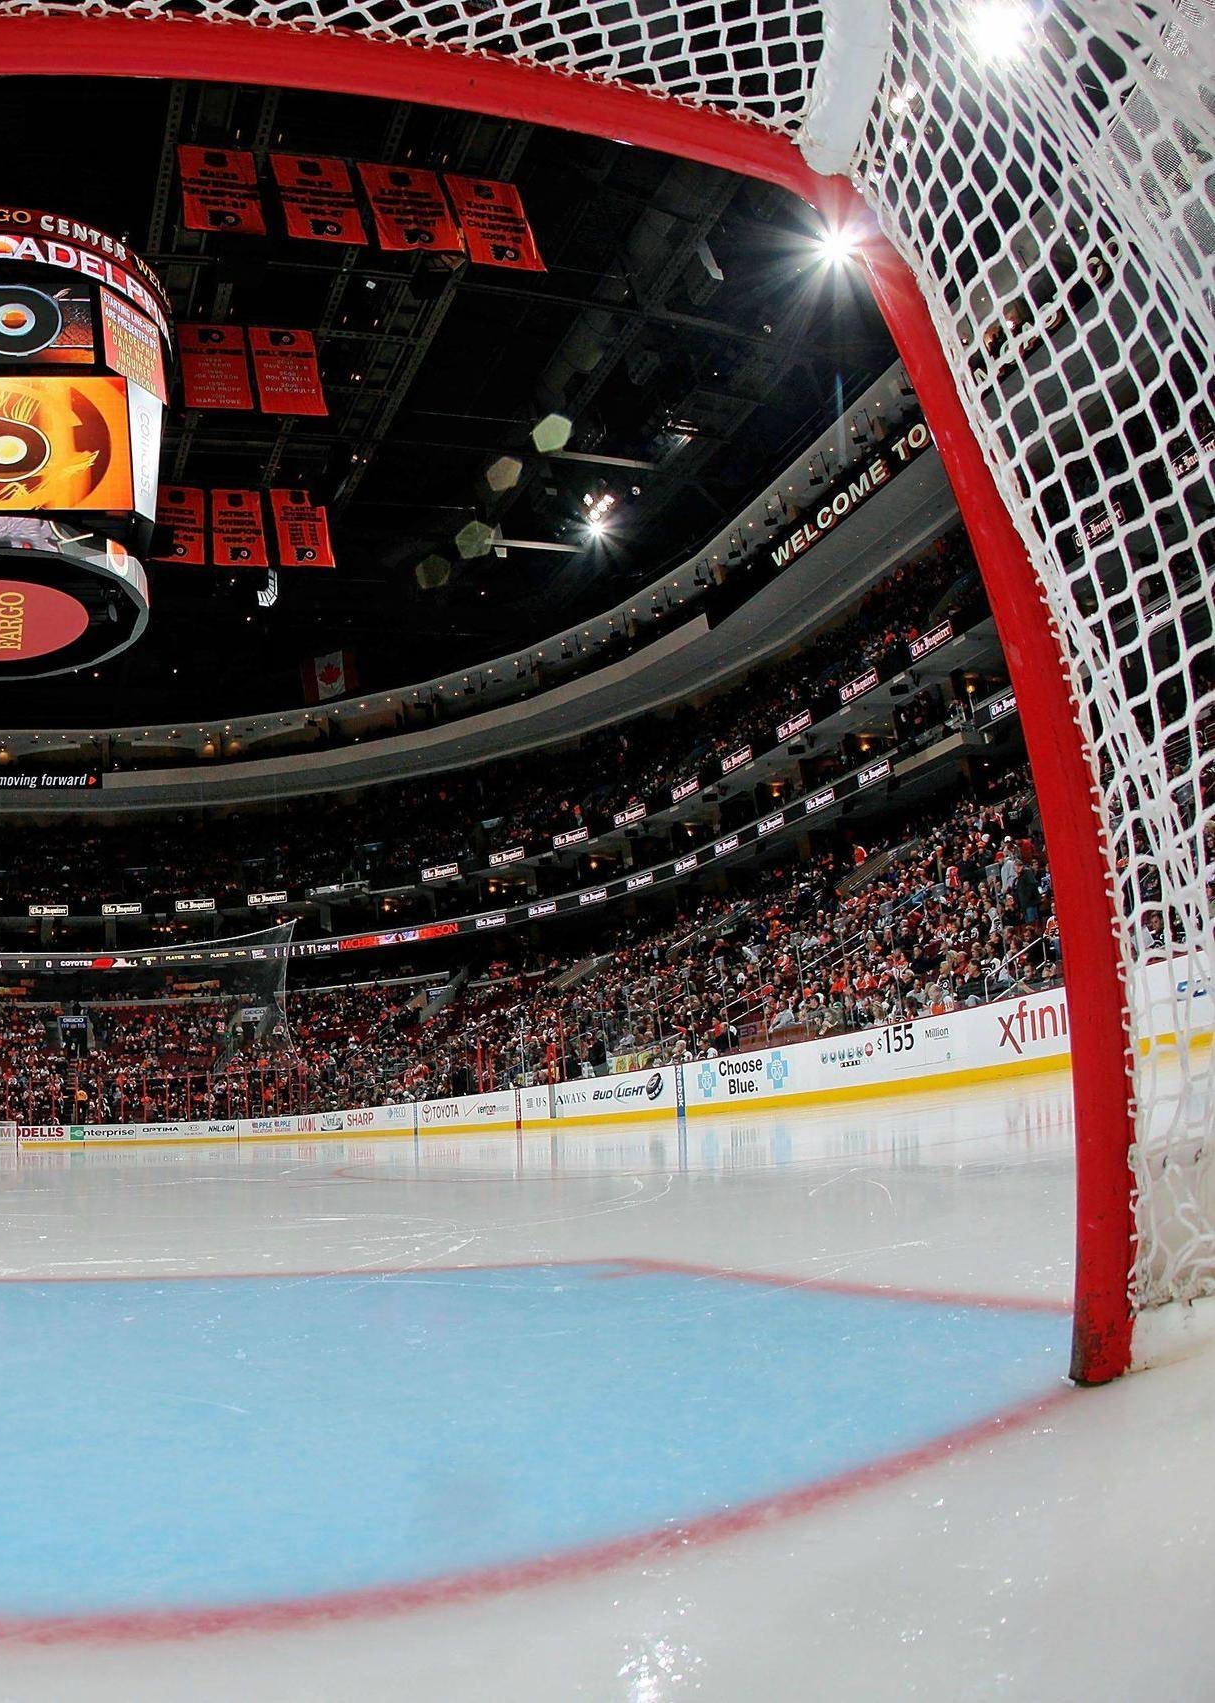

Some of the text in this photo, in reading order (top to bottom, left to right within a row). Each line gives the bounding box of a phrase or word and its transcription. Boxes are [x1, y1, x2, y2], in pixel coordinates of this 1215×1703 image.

[40, 215, 127, 261] CENTER
[108, 319, 157, 360] PHILADELPHIA
[113, 336, 156, 369] DAILY NEWS
[771, 423, 928, 567] WELCOME TO
[911, 623, 950, 658] The Inquirer
[841, 670, 877, 701] The Inquirer
[778, 712, 810, 739] The Inquirer
[41, 773, 86, 786] forward
[859, 762, 889, 785] The Inquirer
[45, 960, 52, 968] 0
[877, 1023, 949, 1054] $155 Million
[718, 1058, 763, 1077] Choose
[592, 1085, 645, 1101] BUD LIGHT
[728, 1078, 759, 1095] Blue.
[432, 1104, 459, 1119] TOYOTA
[477, 1104, 496, 1115] verizon
[535, 1097, 547, 1108] US
[208, 1124, 235, 1132] NHL.COM
[347, 1112, 374, 1127] SHARP
[0, 1127, 64, 1138] MODELL'S
